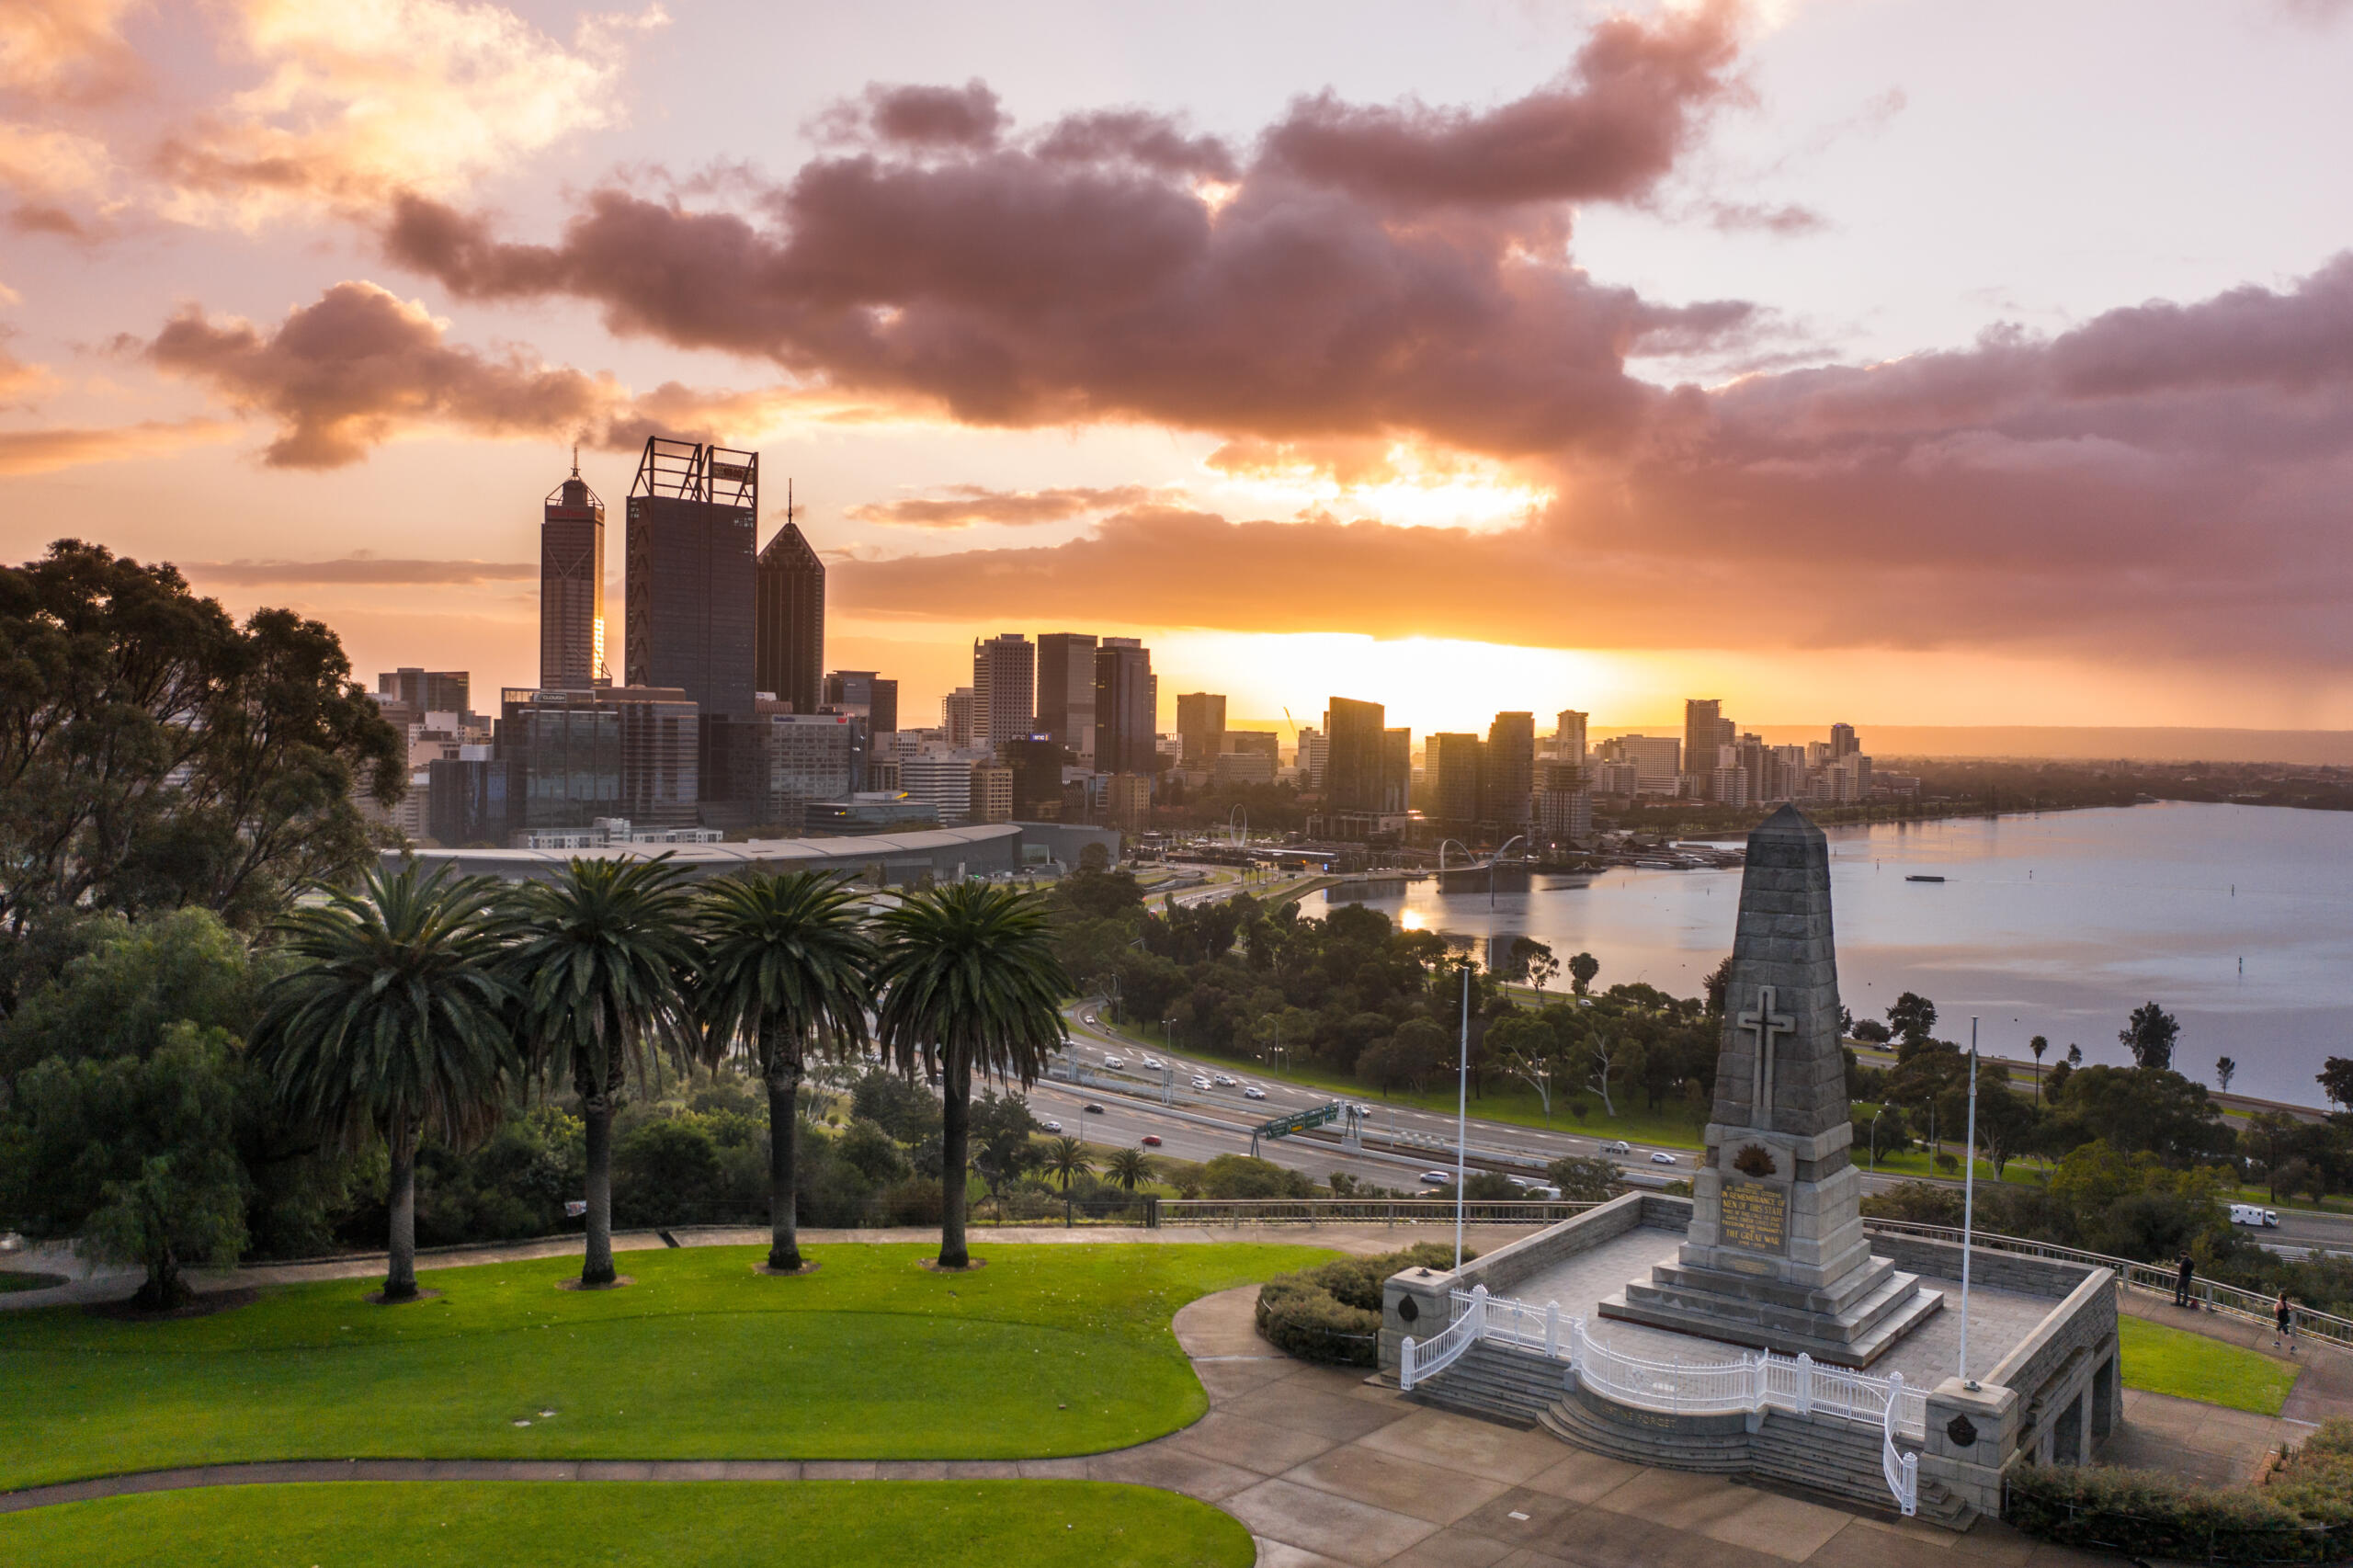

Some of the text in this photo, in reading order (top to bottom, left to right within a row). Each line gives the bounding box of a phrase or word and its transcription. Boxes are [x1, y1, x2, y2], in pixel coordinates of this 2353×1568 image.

[1764, 1206, 1783, 1216] STATE
[1764, 1235, 1780, 1245] WAR
[1636, 1414, 1677, 1428] FORGET
